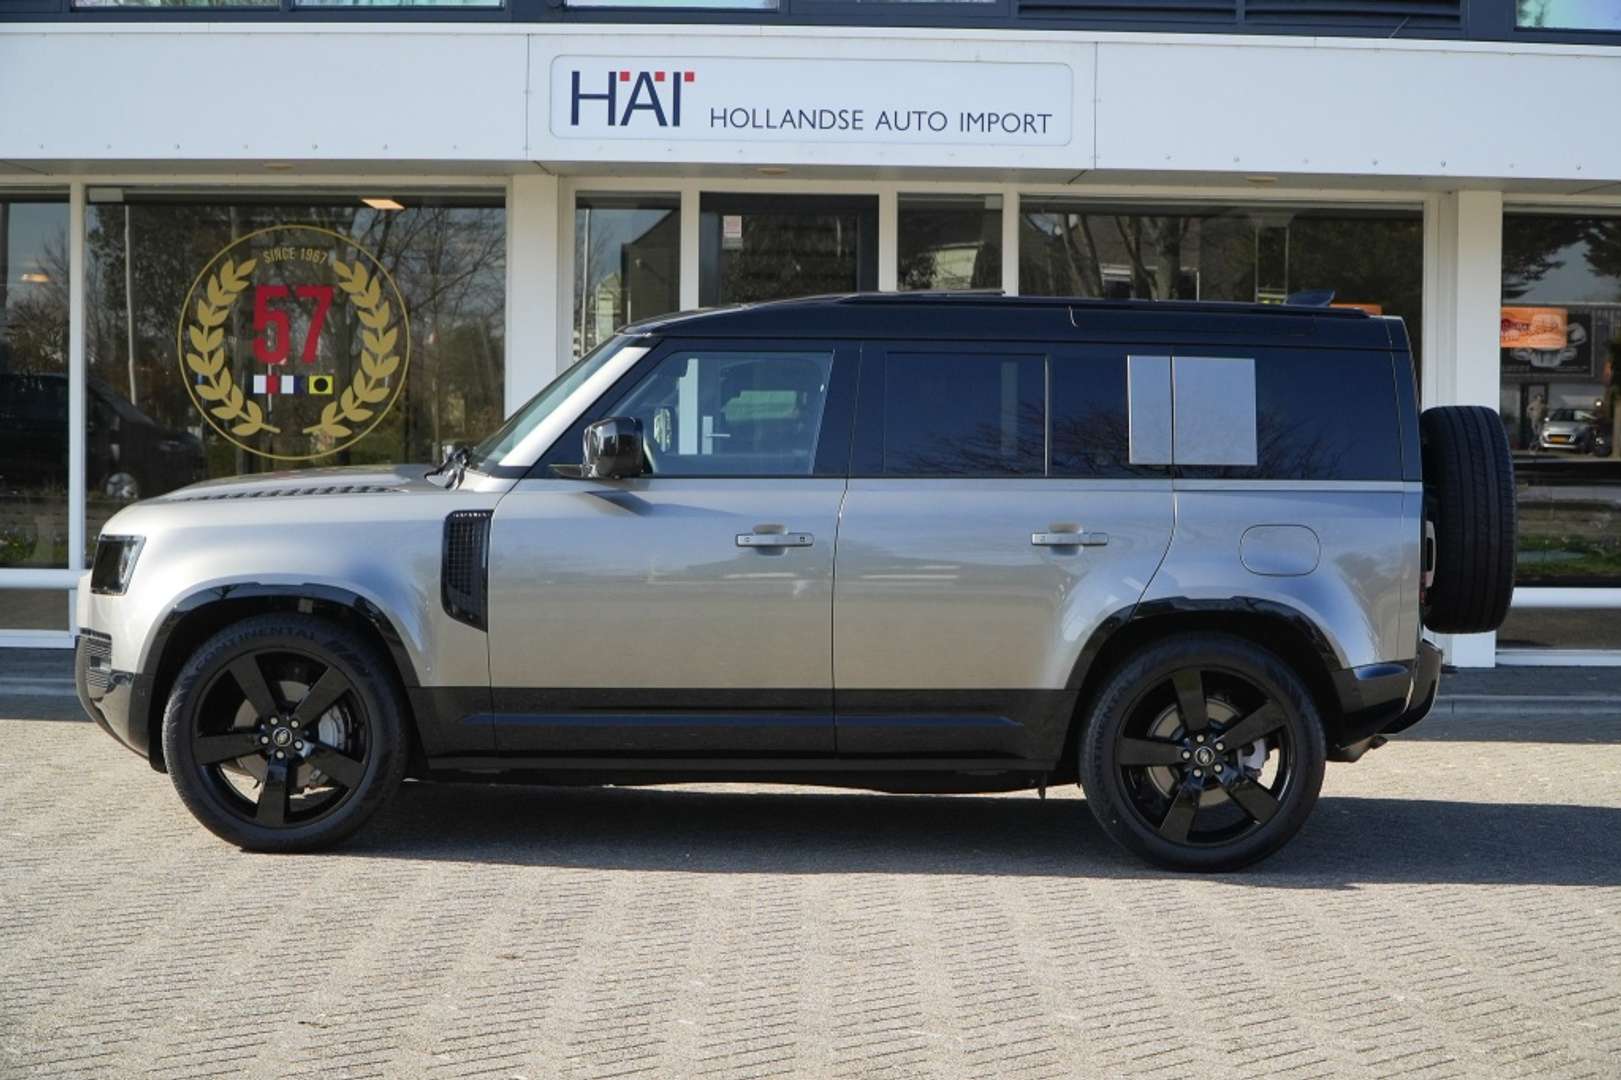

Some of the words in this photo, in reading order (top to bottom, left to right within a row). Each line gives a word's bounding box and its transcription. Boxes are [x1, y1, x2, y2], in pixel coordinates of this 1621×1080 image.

[710, 108, 863, 130] HOLLANDSE
[875, 111, 948, 132] AUTO
[960, 112, 1052, 134] IMPORT
[263, 248, 295, 263] SINCE
[300, 248, 328, 263] 1967
[253, 286, 333, 363] 57
[193, 627, 315, 672] CONTINENTAL
